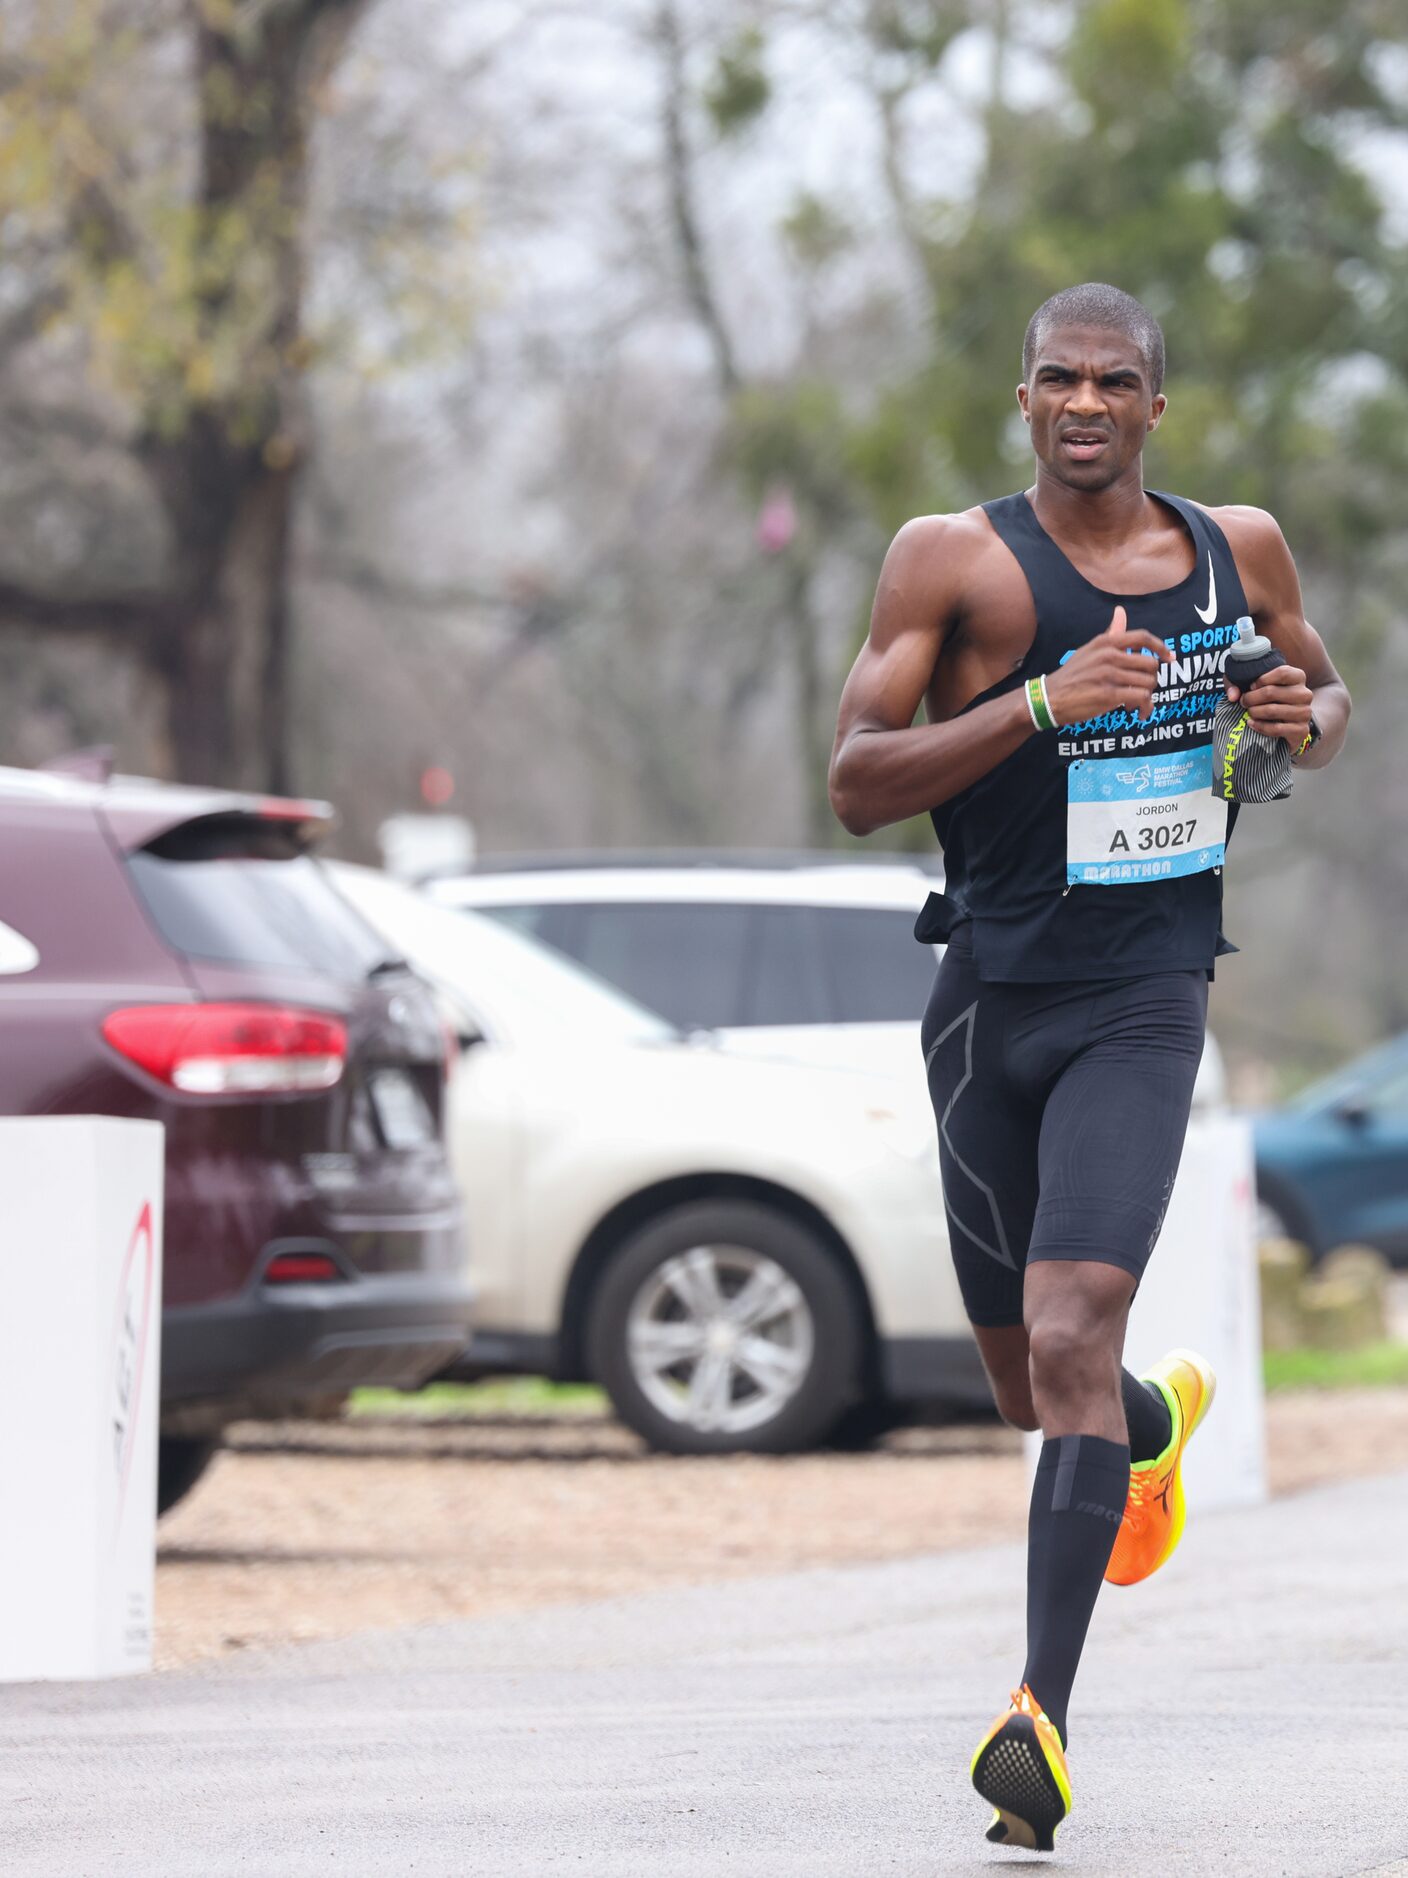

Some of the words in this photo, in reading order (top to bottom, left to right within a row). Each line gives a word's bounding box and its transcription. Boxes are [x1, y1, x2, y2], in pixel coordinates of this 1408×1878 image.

[1180, 623, 1240, 654] SPORTS
[1186, 678, 1214, 694] 1978
[1058, 738, 1116, 756] ELITE
[1187, 717, 1216, 735] TEA
[1223, 711, 1250, 799] ATHAN
[1153, 769, 1189, 781] MARATHON
[1153, 778, 1183, 788] FESTIVAL
[1136, 803, 1178, 816] JORDON
[1109, 829, 1131, 853] A
[1138, 819, 1198, 850] 3027
